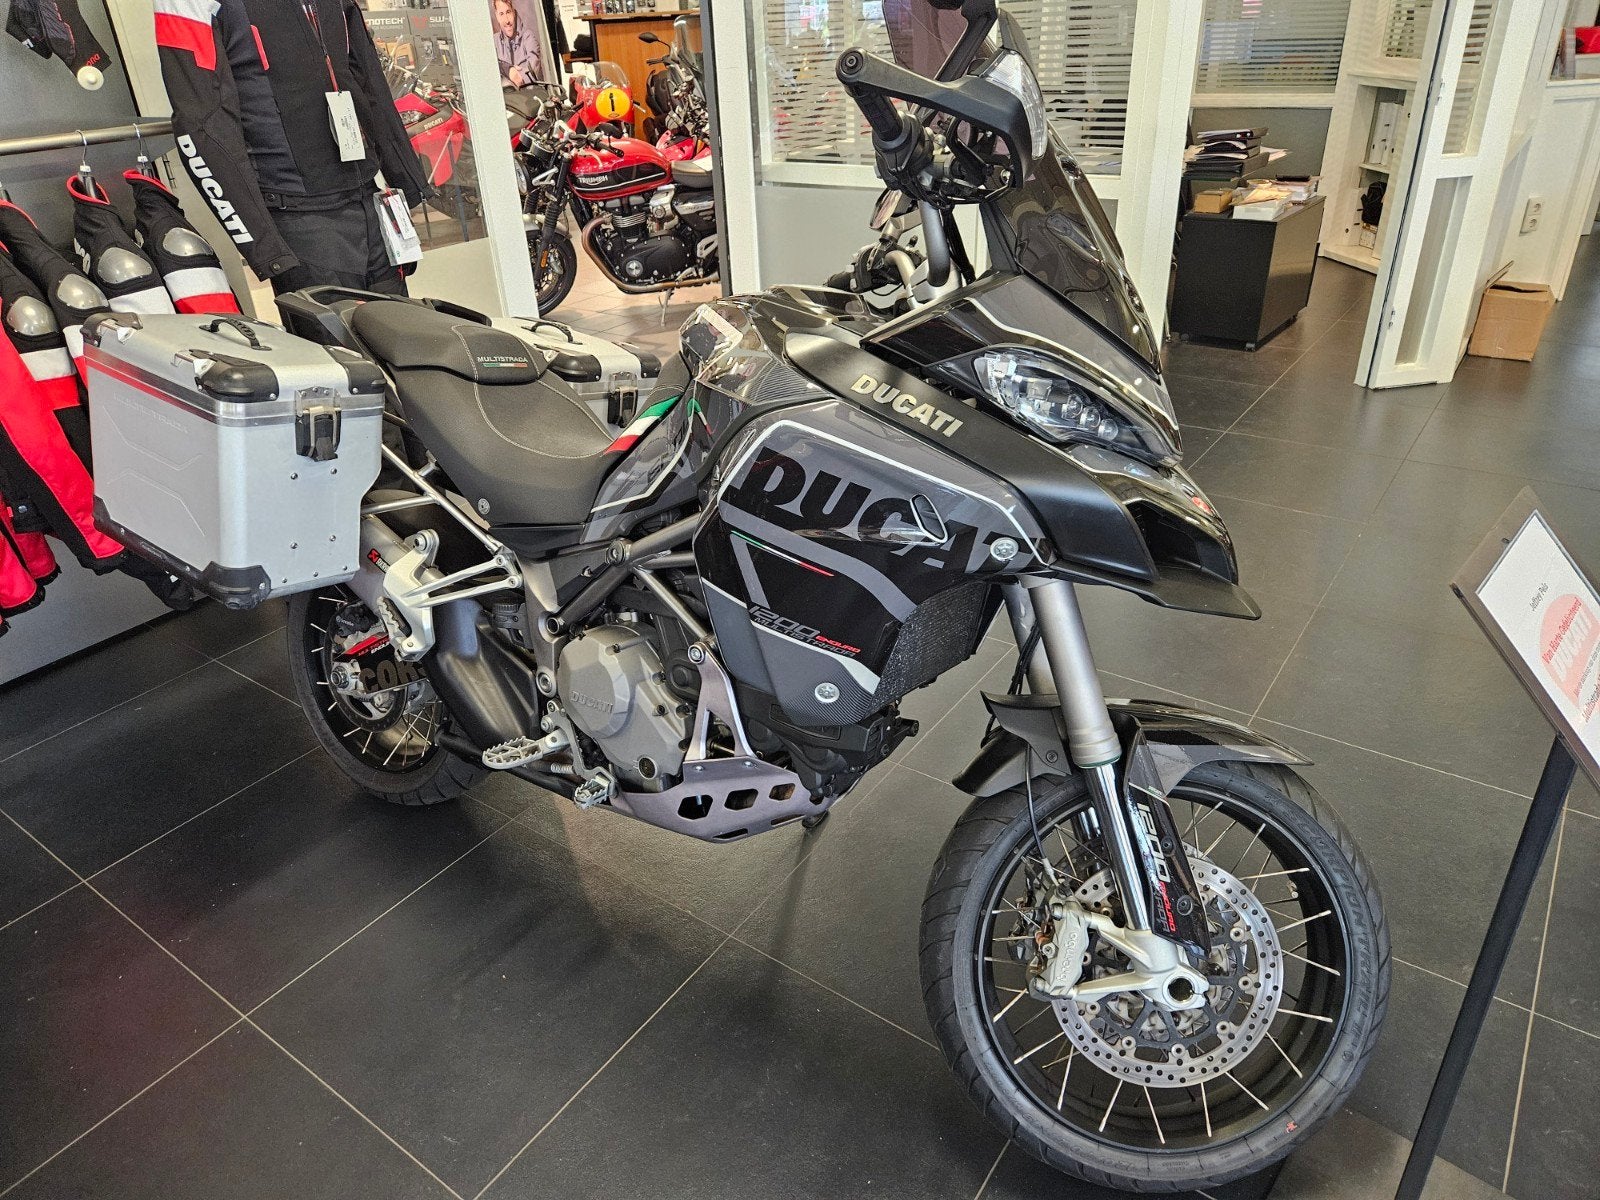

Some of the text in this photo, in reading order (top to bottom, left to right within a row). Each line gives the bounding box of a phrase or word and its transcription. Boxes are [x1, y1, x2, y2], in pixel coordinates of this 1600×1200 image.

[608, 92, 616, 112] 1
[177, 134, 254, 244] DUCATI
[578, 174, 609, 186] TRIUMPH
[850, 374, 964, 438] DUCATI
[749, 605, 861, 653] 1200 ENDURO
[360, 660, 427, 694] COR
[570, 690, 614, 714] DUCATI
[1136, 802, 1171, 883] 1200
[1056, 931, 1079, 982] brembo
